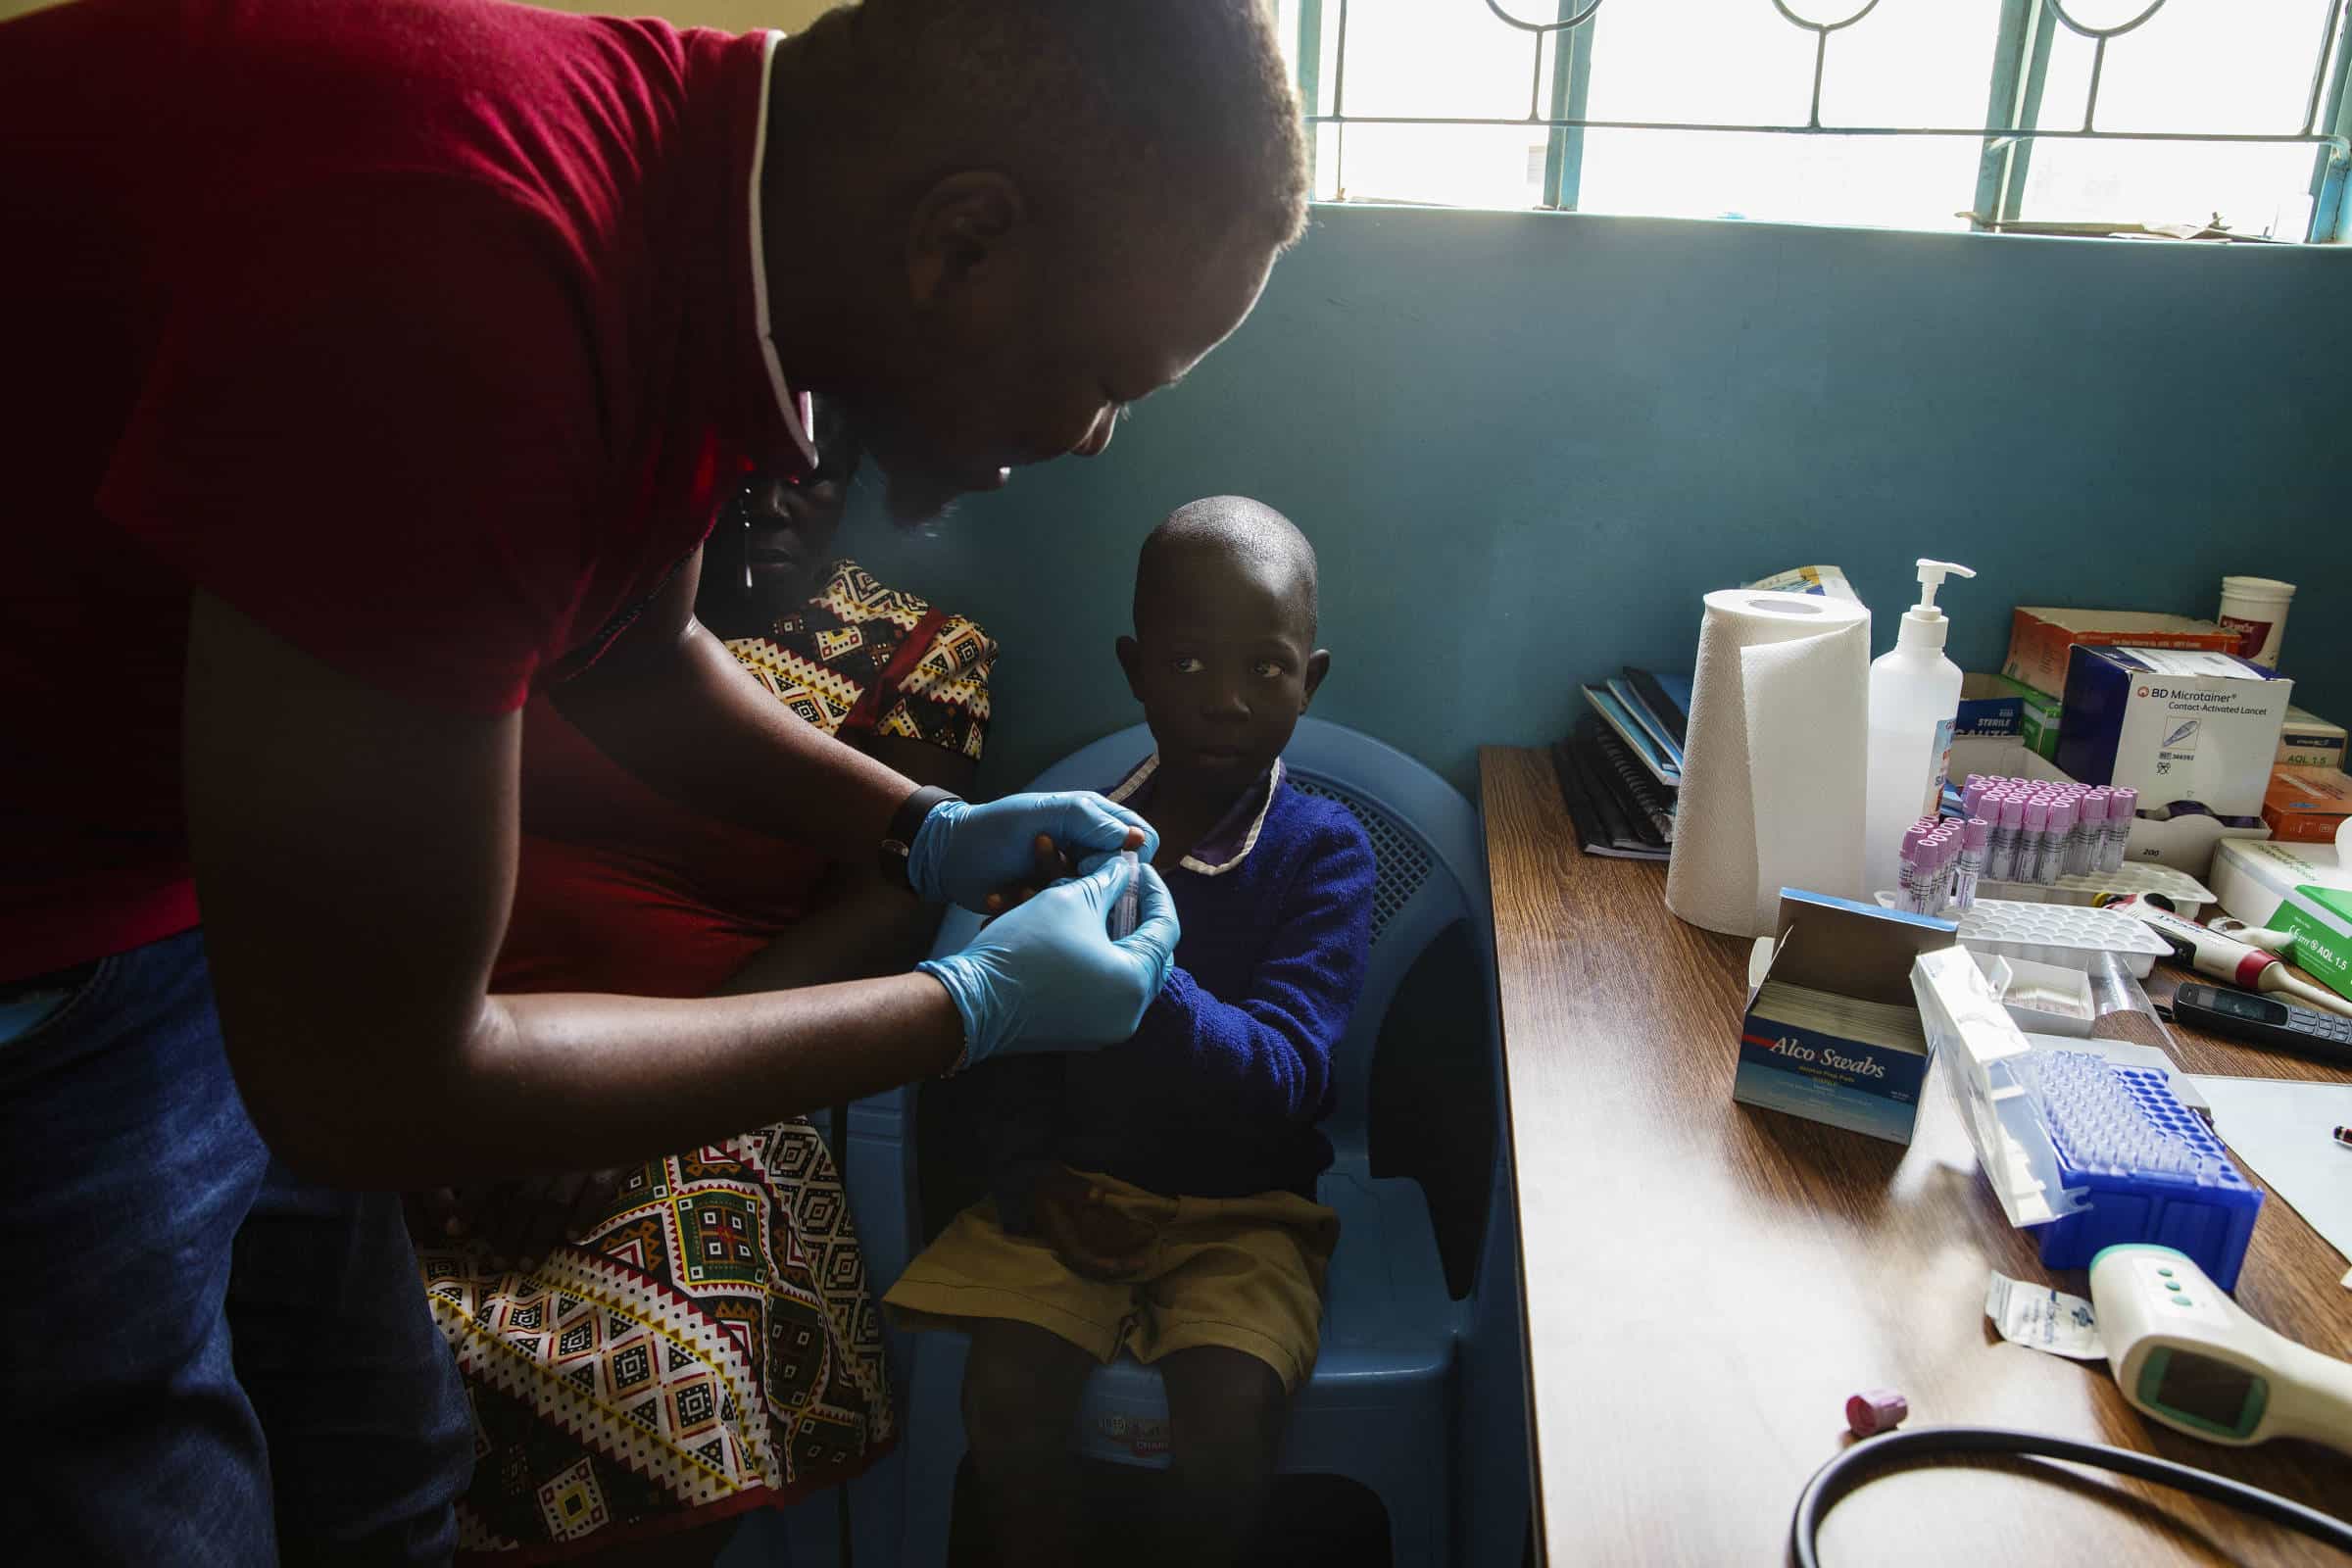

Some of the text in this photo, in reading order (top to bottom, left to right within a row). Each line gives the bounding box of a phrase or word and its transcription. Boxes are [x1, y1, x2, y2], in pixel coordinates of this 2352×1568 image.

[2151, 688, 2169, 699] BD
[2169, 702, 2268, 715] Contact-Activated Lancet
[2316, 946, 2333, 963] AQL
[2335, 956, 2347, 971] 1.5
[1771, 1037, 1816, 1061] Alco
[1821, 1049, 1885, 1078] Swabs
